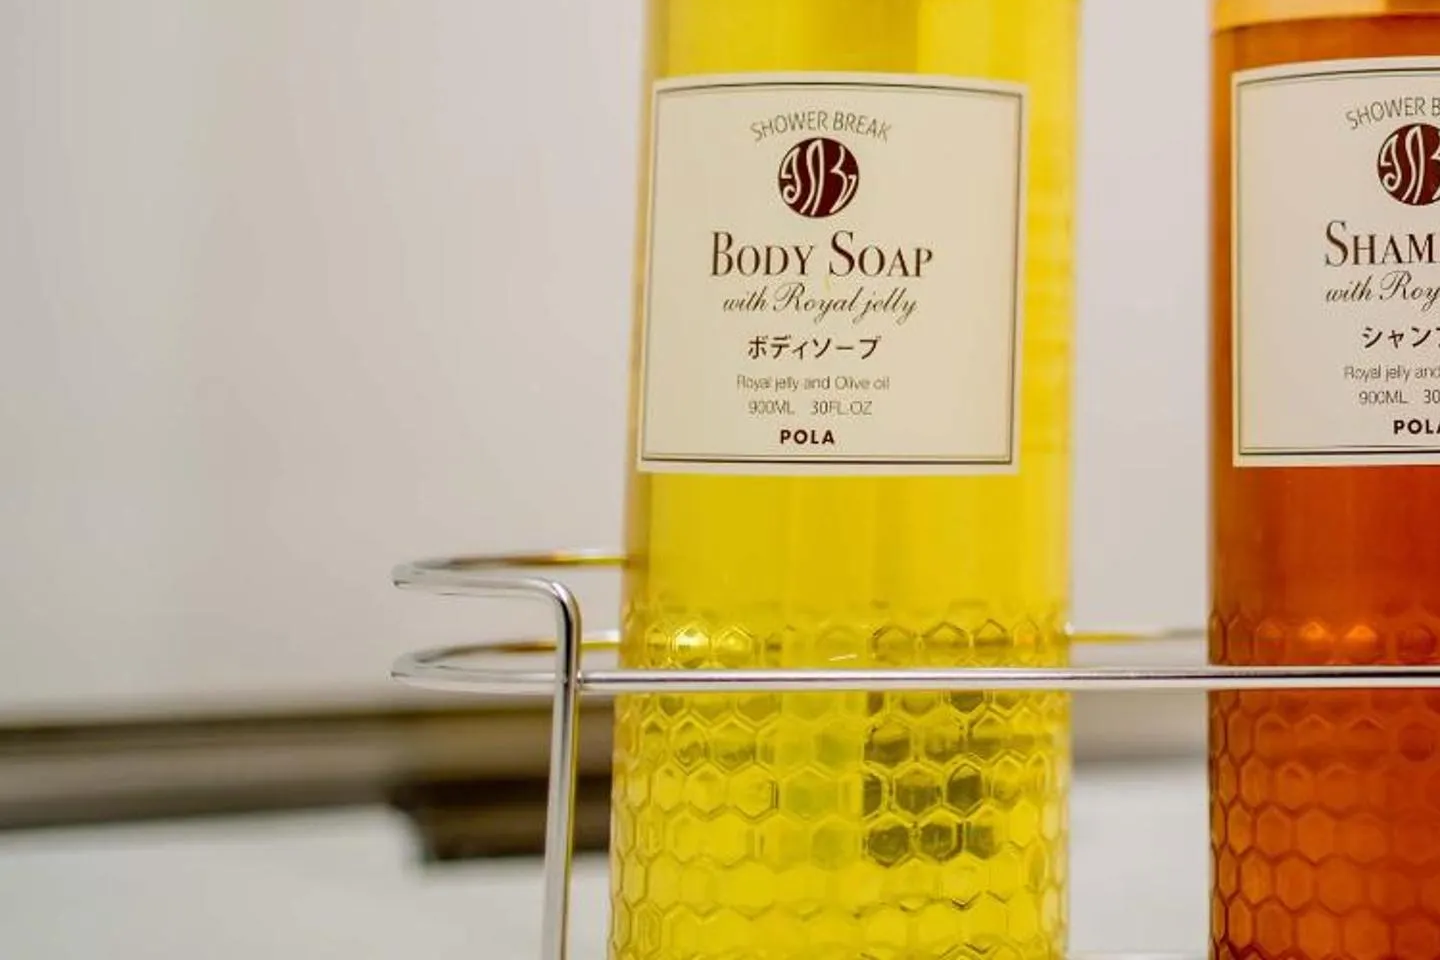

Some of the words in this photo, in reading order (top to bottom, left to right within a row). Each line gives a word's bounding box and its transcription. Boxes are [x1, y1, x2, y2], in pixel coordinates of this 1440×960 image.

[1345, 97, 1426, 130] SHOWER
[750, 111, 829, 141] SHOWER
[833, 112, 891, 141] BREAK
[711, 231, 815, 277] BODY
[828, 230, 933, 277] SOAP
[1326, 274, 1373, 302] with
[723, 284, 768, 312] with
[773, 282, 858, 322] Royal
[853, 287, 918, 324] jelly
[737, 375, 770, 391] Royal
[774, 376, 799, 391] jelly
[803, 376, 830, 390] and
[834, 376, 870, 389] Olive
[873, 377, 890, 389] oil
[1344, 365, 1382, 381] Royal
[1385, 365, 1411, 380] jelly
[748, 401, 795, 415] 900ML
[1359, 390, 1407, 404] 900ML
[780, 430, 834, 445] POLA
